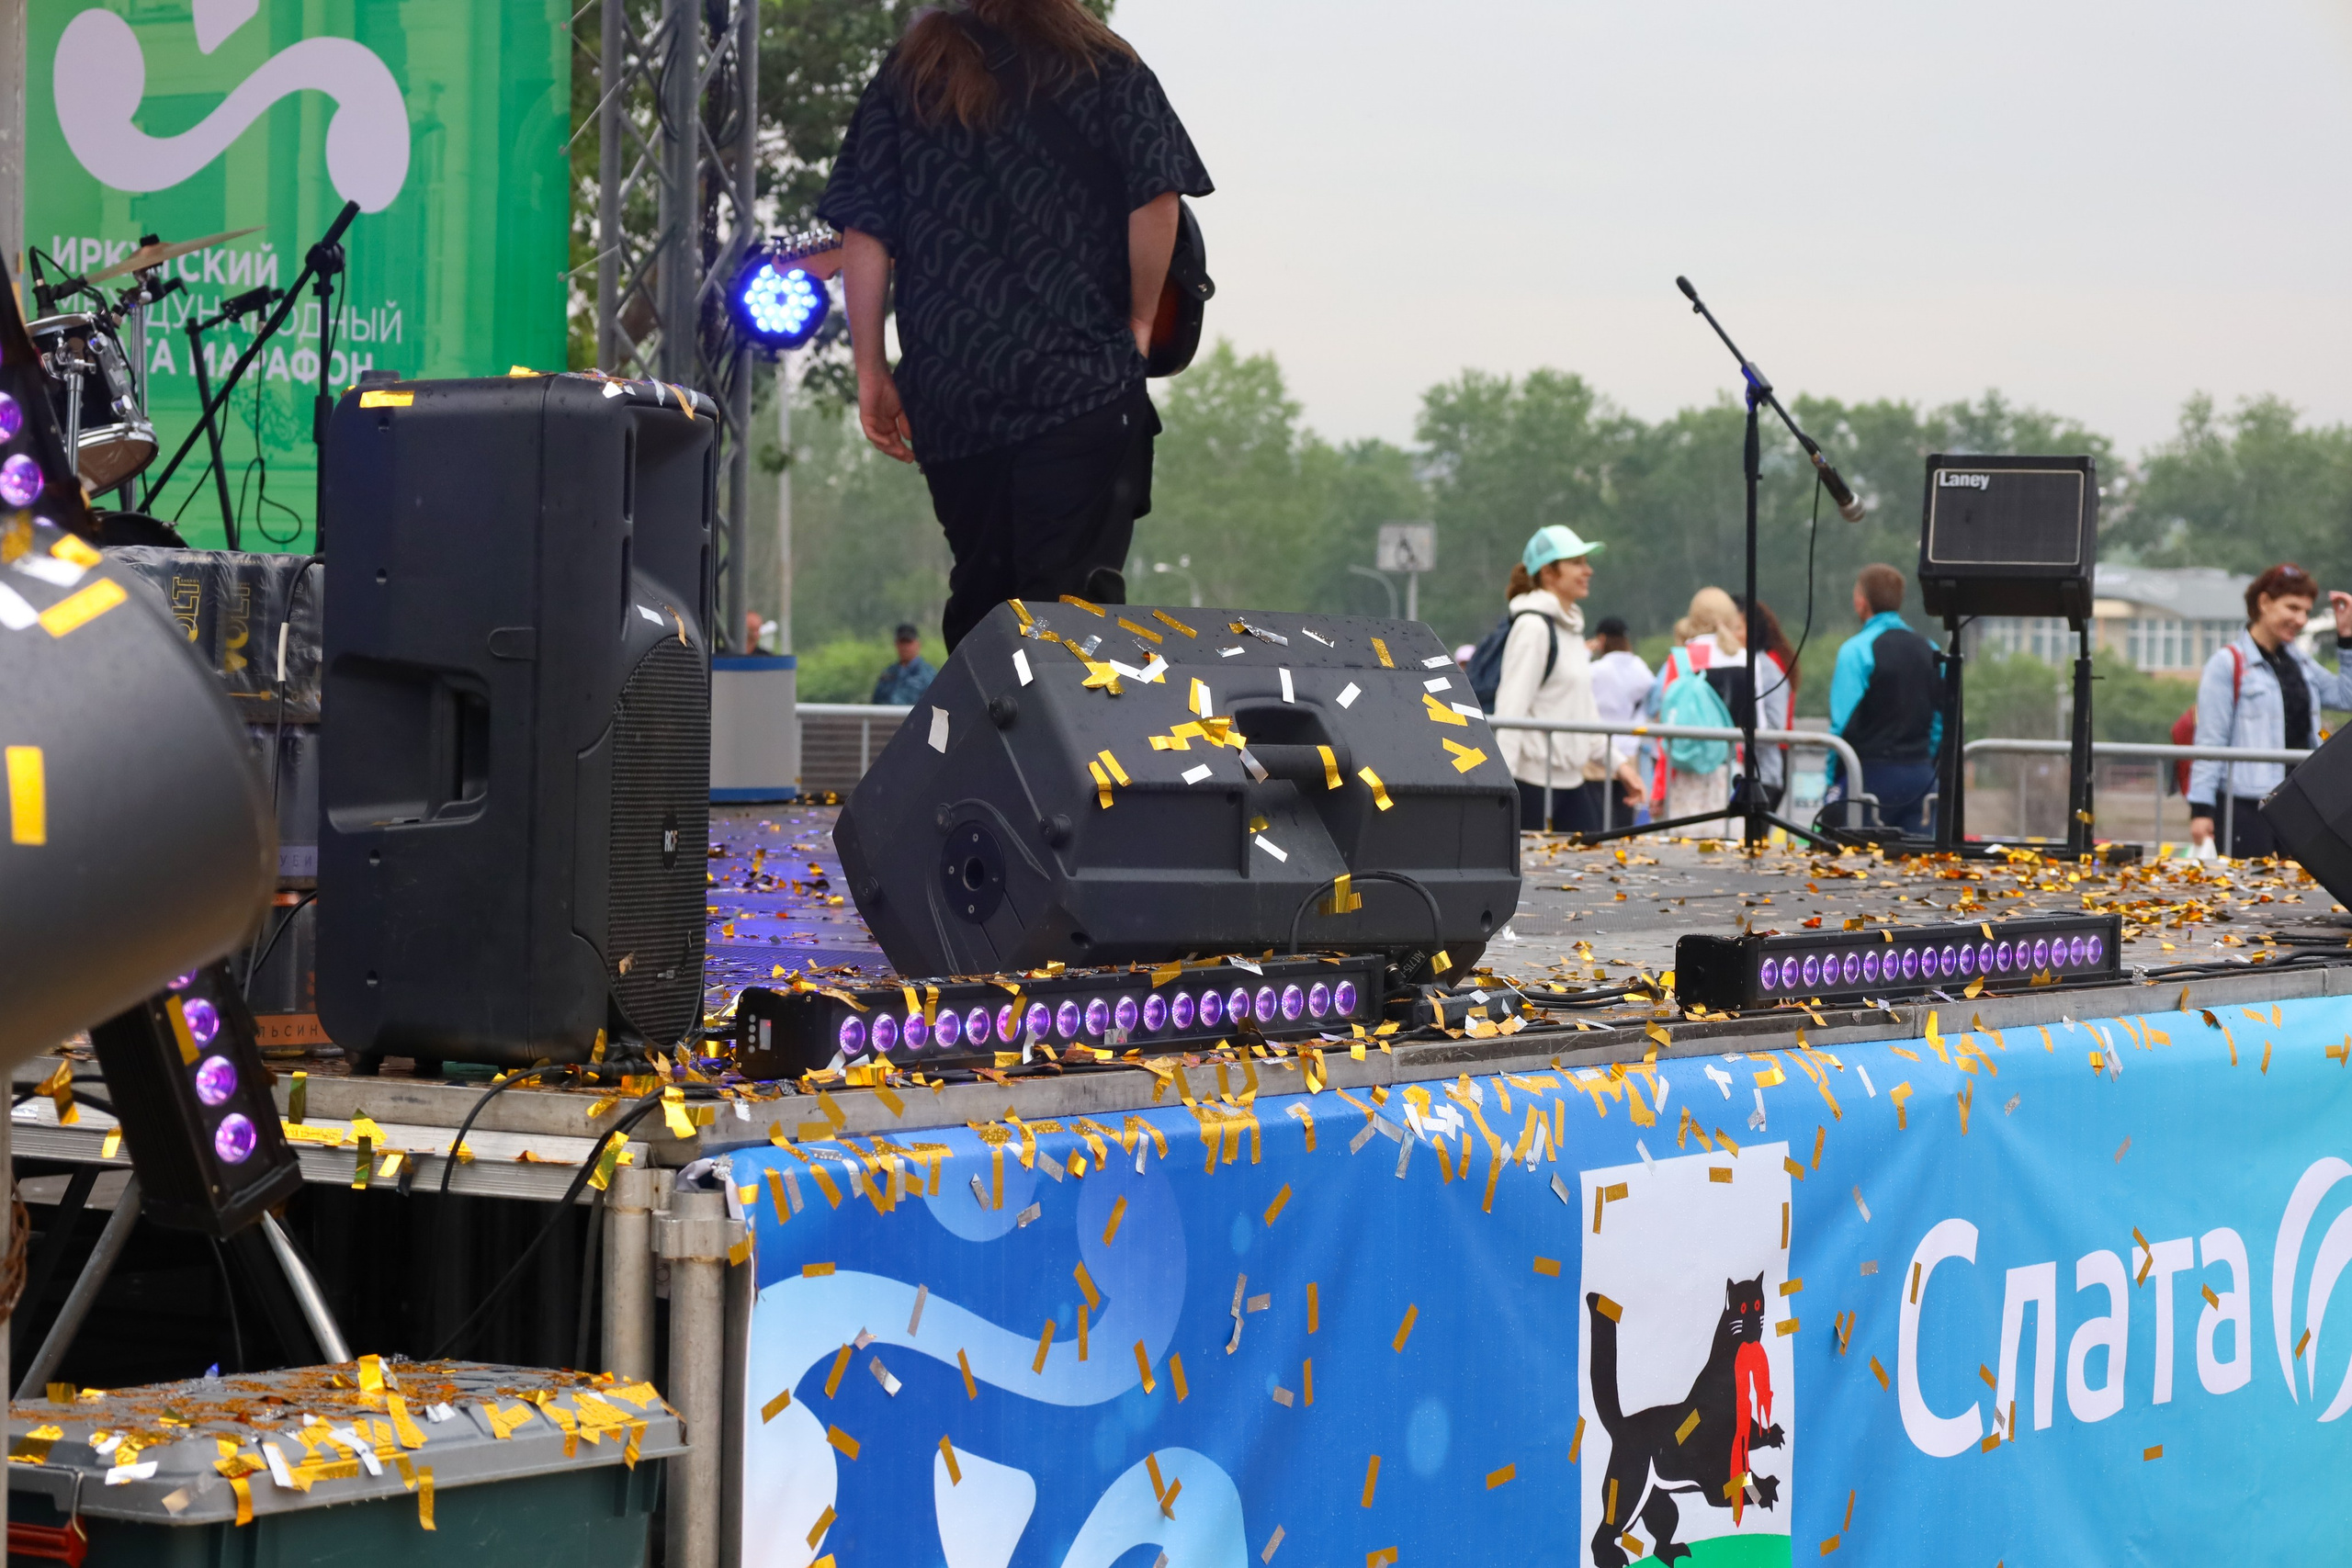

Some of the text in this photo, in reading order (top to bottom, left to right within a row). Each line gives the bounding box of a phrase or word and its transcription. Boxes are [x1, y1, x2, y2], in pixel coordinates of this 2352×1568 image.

[1939, 470, 1990, 491] Laney
[664, 829, 678, 852] RCF
[257, 1024, 318, 1038] ЛЬСИН
[1897, 1218, 2252, 1459] Слата
